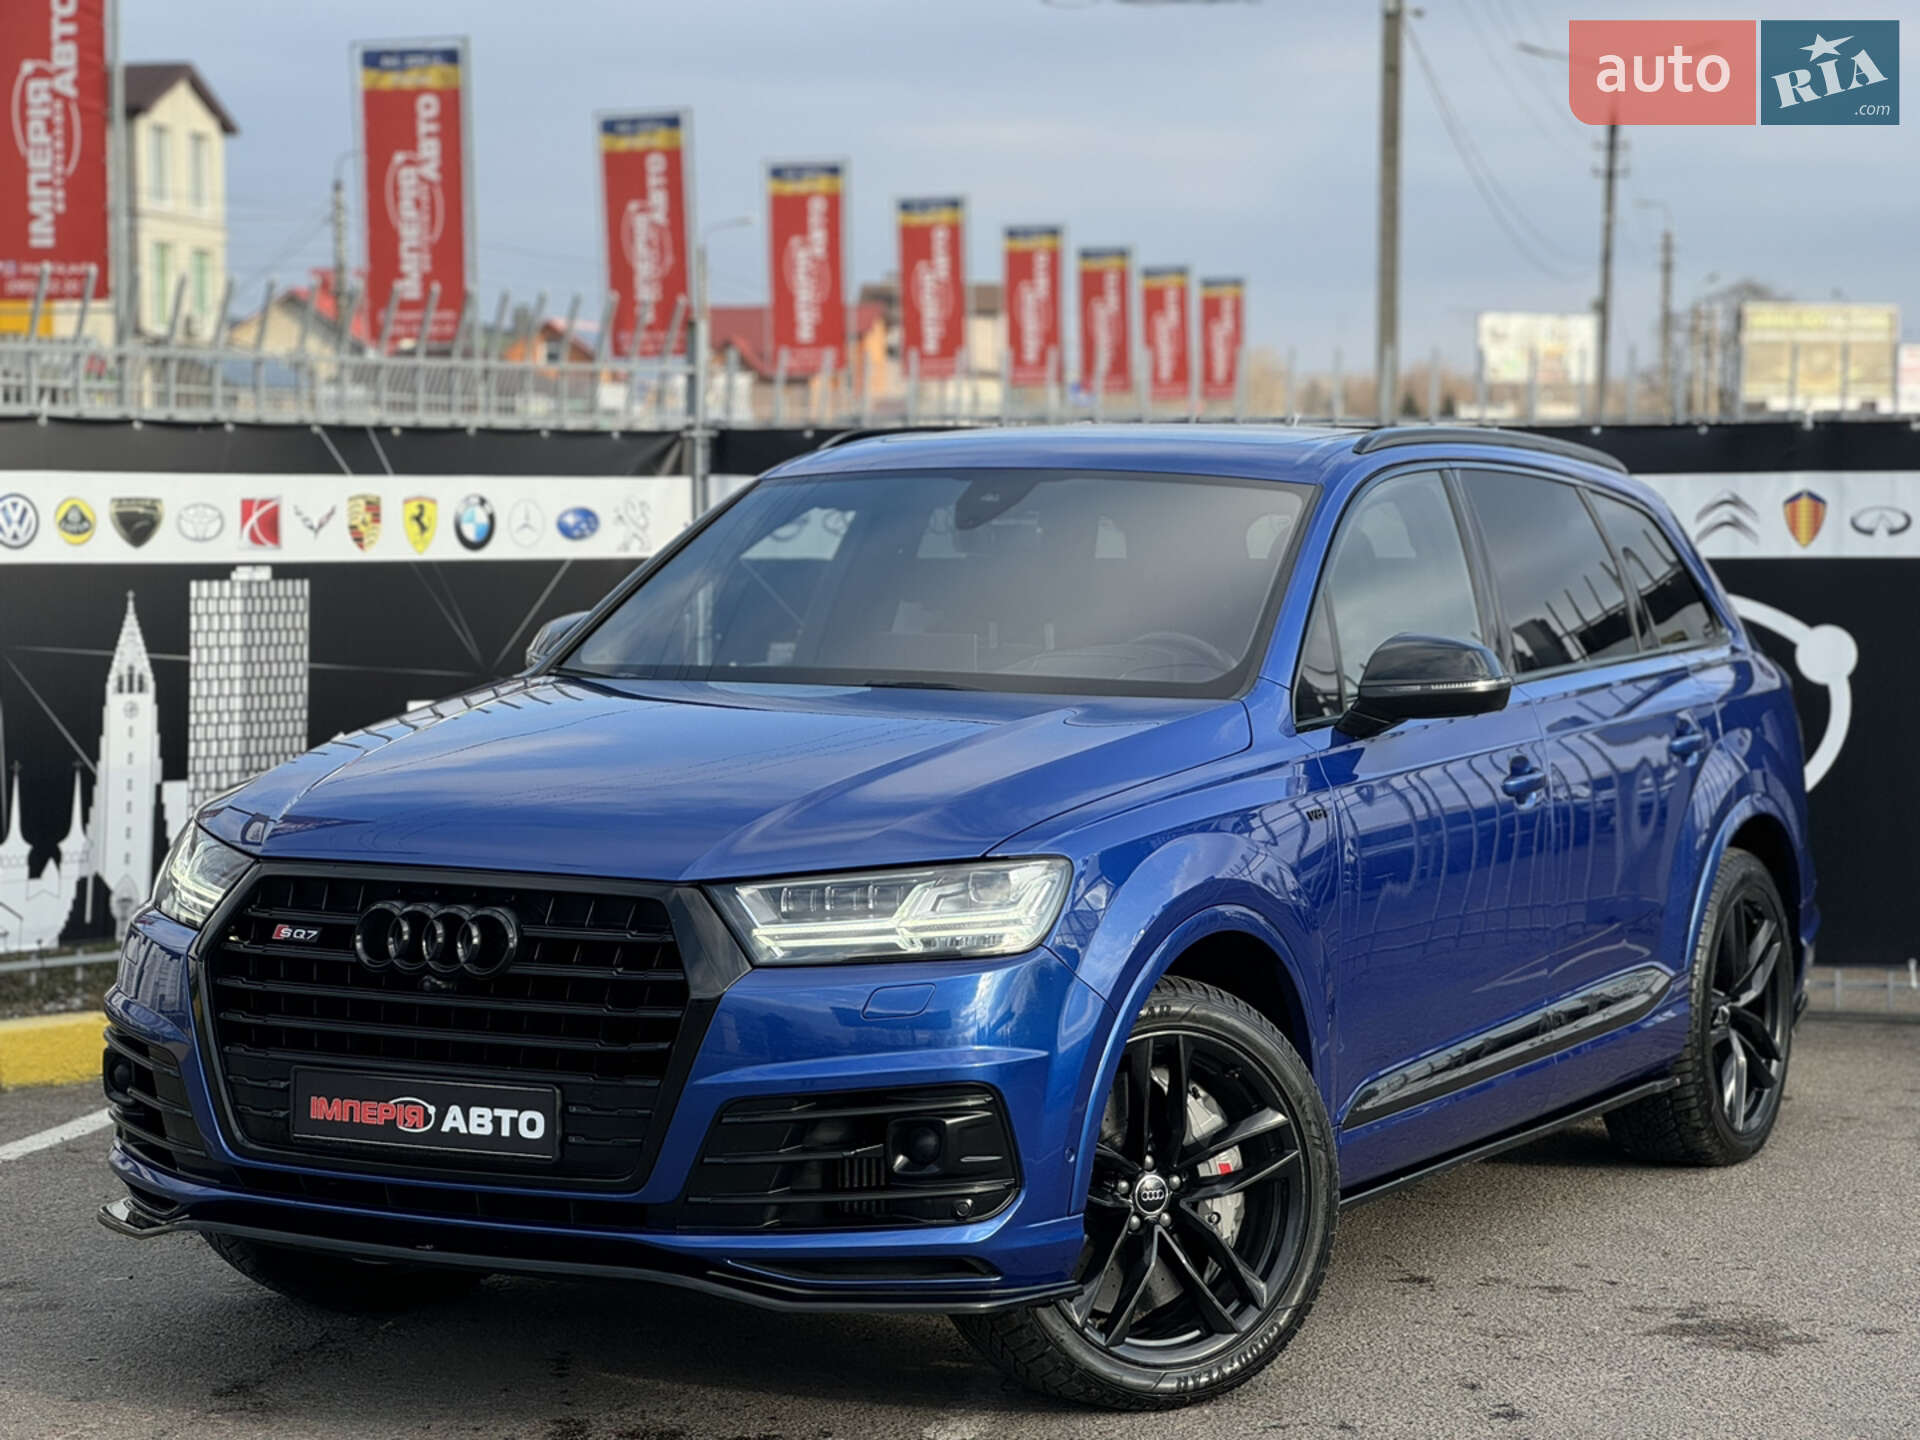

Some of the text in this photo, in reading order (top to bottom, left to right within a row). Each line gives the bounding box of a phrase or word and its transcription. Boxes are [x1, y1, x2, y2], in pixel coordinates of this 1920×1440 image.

[26, 77, 56, 249] ІМПЕРІЯ
[416, 93, 442, 182] АВТО
[278, 926, 319, 941] SQ7
[309, 1096, 545, 1140] ІМПЕРІЯ АВТО
